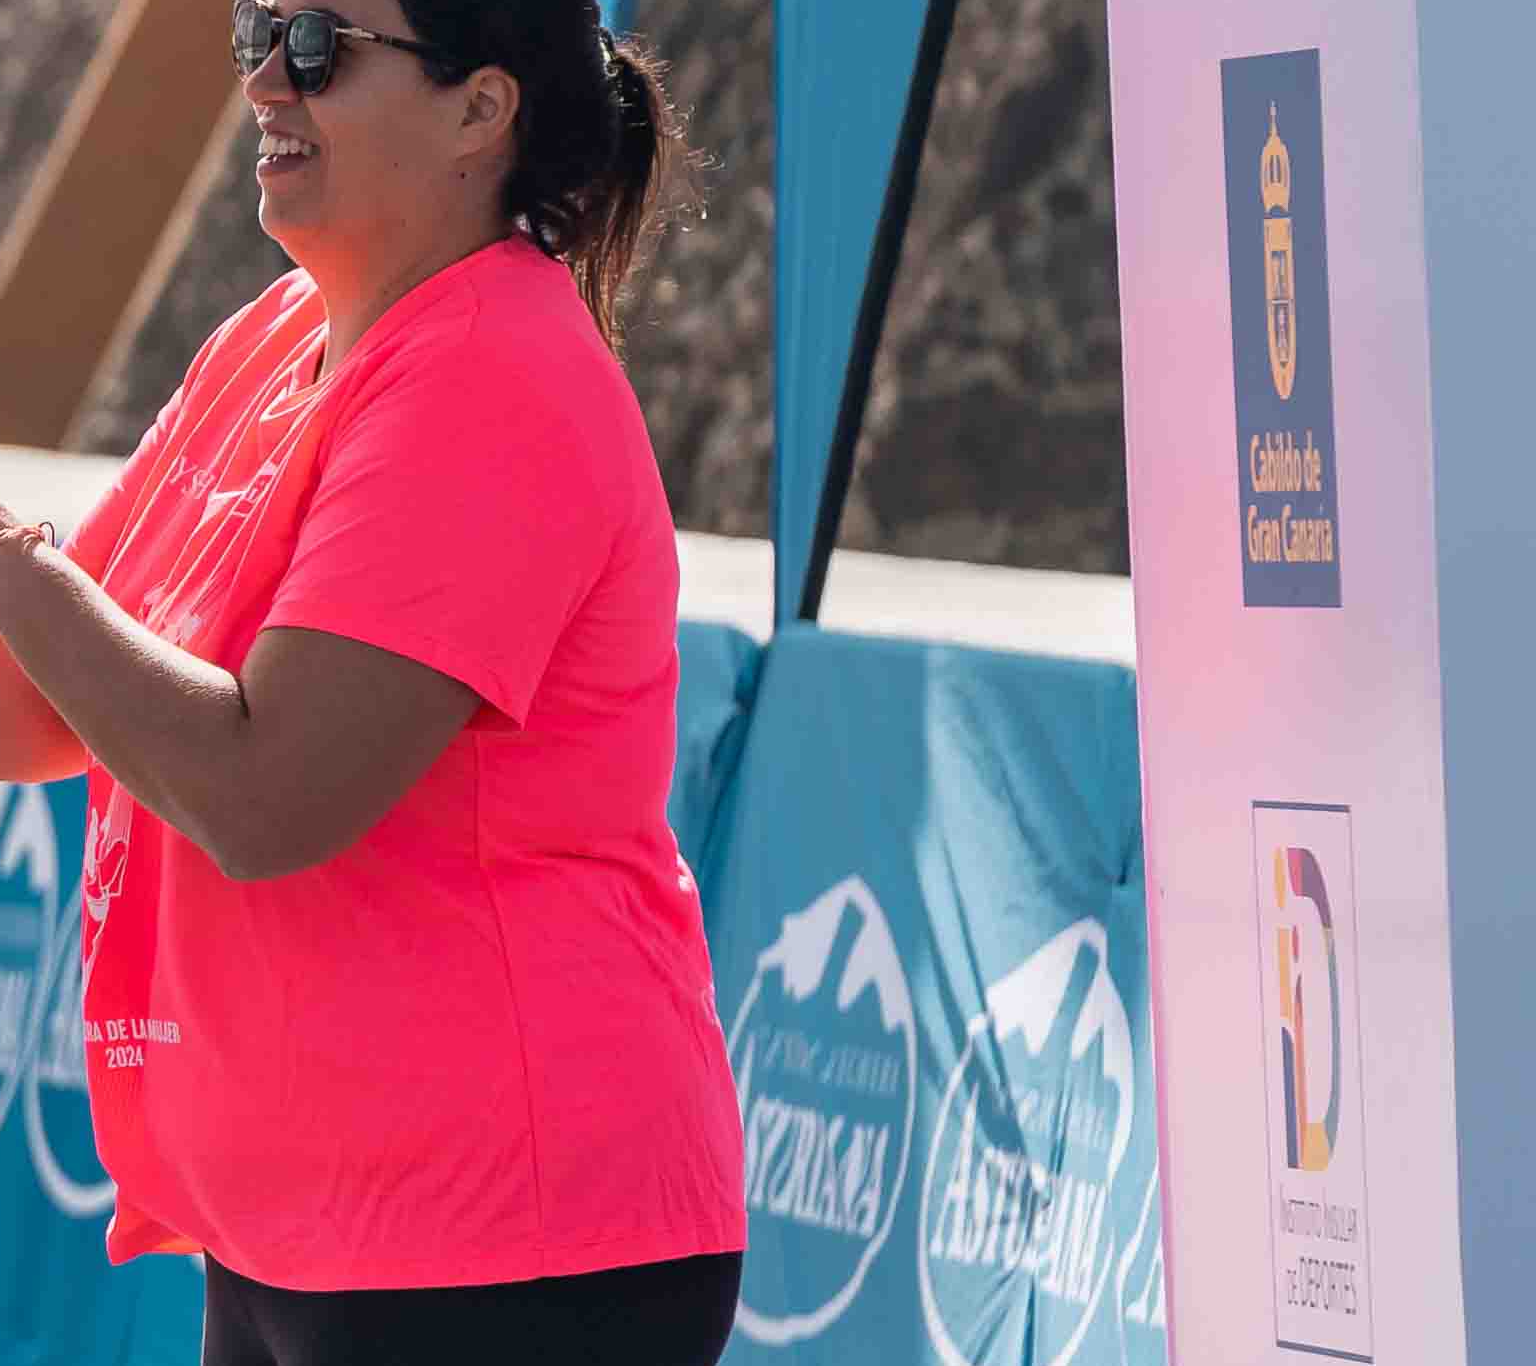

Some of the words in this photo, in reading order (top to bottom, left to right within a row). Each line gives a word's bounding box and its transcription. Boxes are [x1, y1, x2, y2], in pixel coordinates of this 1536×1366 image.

[1250, 431, 1301, 491] Cabildo
[1303, 428, 1321, 491] de
[1248, 504, 1281, 562] Gran
[1282, 503, 1333, 562] Canaria
[106, 1019, 129, 1041] DE
[105, 1046, 144, 1068] 2024
